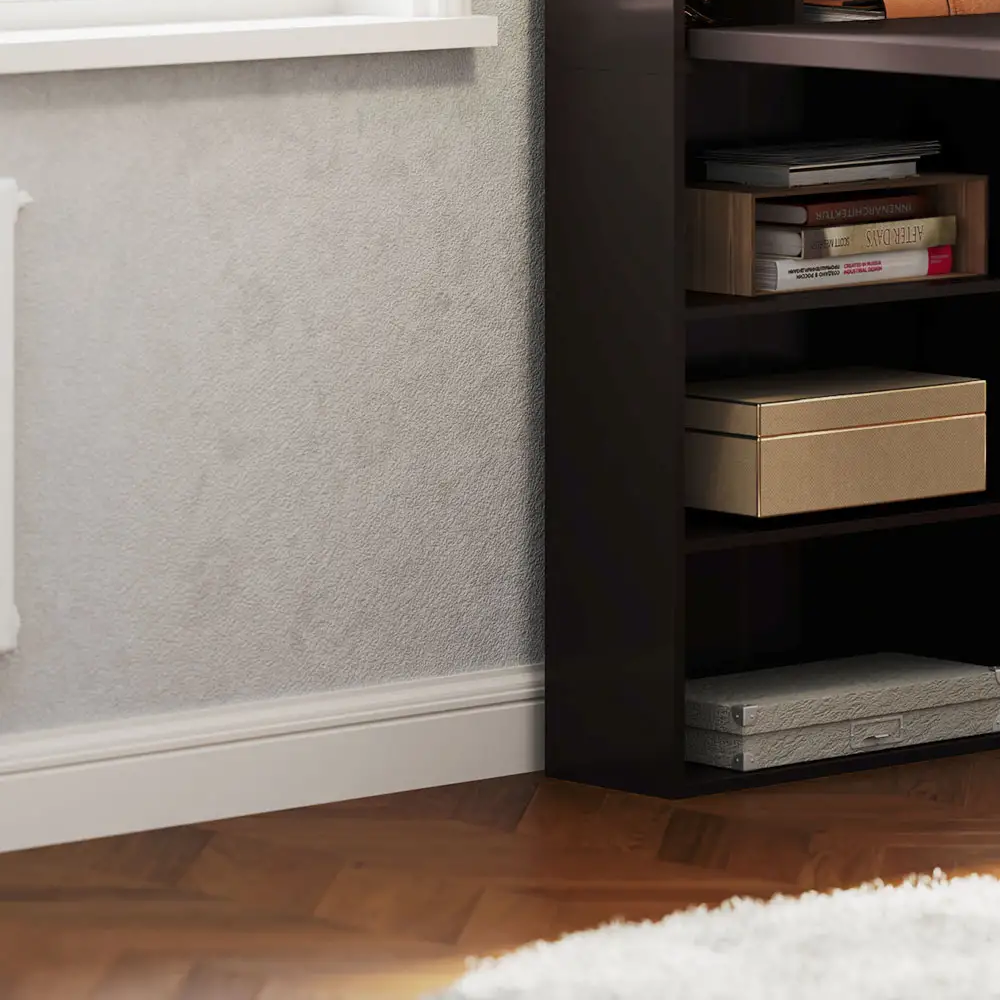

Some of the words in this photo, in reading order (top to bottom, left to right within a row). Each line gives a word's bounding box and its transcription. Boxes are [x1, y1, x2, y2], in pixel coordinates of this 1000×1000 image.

[815, 203, 912, 221] INNENARCHITEKTUR
[865, 228, 890, 248] DAYS
[894, 224, 924, 245] AFTER
